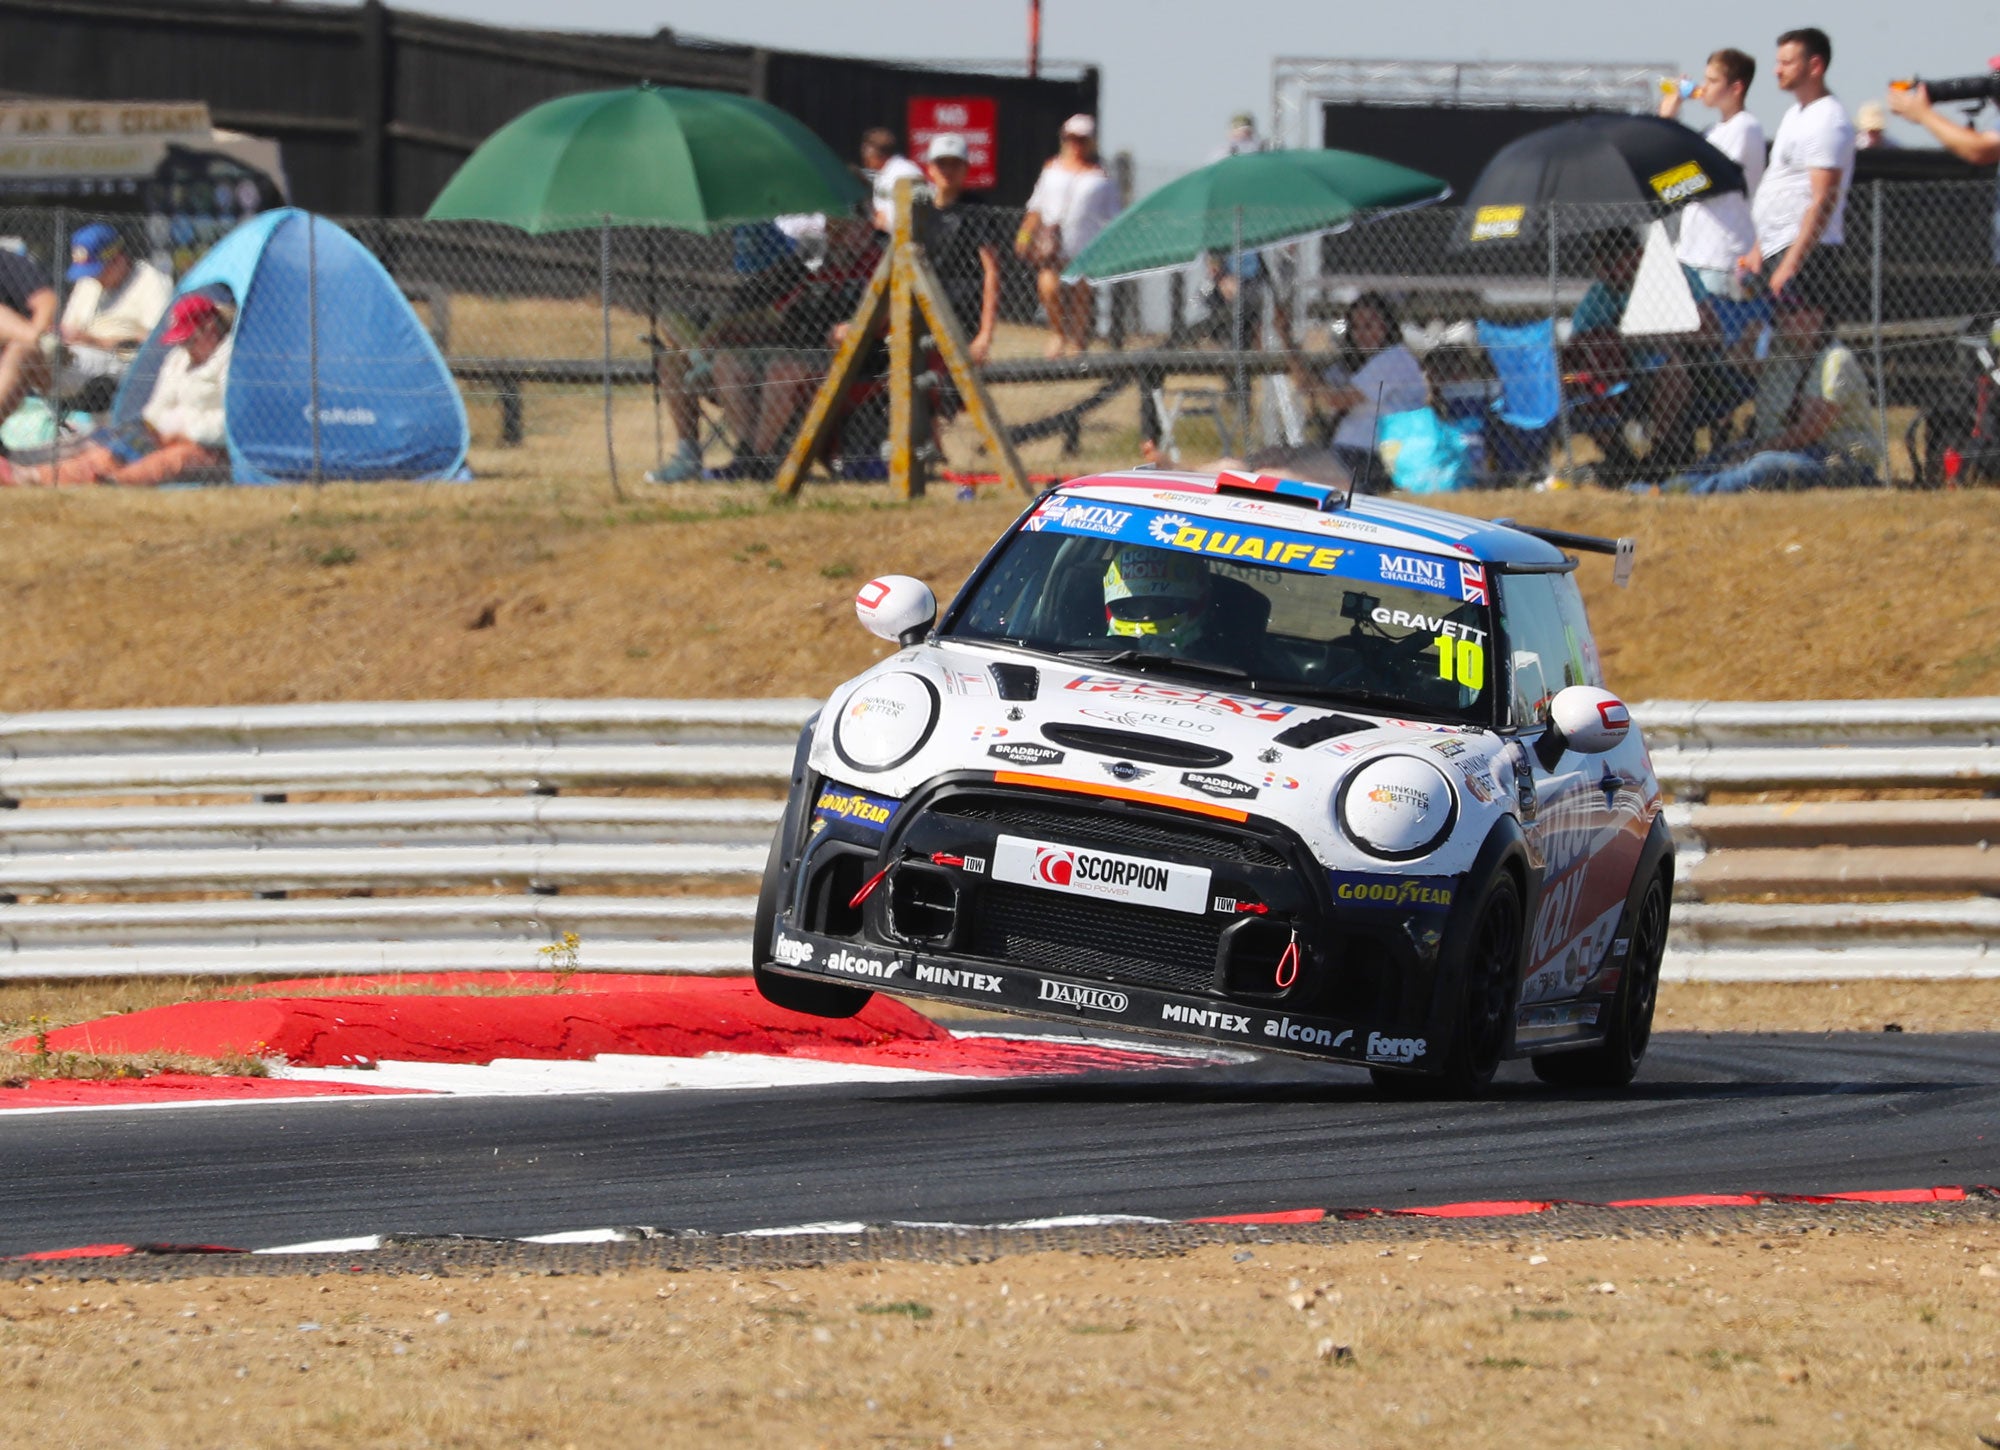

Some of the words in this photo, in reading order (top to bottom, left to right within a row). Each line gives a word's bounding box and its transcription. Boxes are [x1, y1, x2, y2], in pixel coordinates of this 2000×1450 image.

[1172, 526, 1344, 570] QUAIFE
[1379, 554, 1445, 579] MINI
[1380, 571, 1446, 589] CHALLENGE
[1371, 607, 1488, 645] GRAVETT
[1434, 634, 1484, 690] 10
[1124, 710, 1215, 733] CREDO
[995, 744, 1059, 759] BRADBURY
[1008, 753, 1038, 763] RACING
[1113, 766, 1135, 776] MINI
[1187, 773, 1253, 793] BRADBURY
[1202, 783, 1233, 795] RACING
[1374, 783, 1429, 801] THINKING
[1390, 793, 1429, 811] BETTER
[965, 857, 984, 872] TOW
[1076, 855, 1169, 892] SCORPION
[1073, 881, 1093, 890] RED
[1093, 884, 1129, 896] POWER
[1216, 898, 1235, 912] TOW
[827, 949, 883, 978] alcon
[915, 964, 1003, 993] MINTEX
[1037, 978, 1126, 1011] DAMICO
[1162, 1003, 1251, 1034] MINTEX
[1264, 1016, 1334, 1047] alcon
[1366, 1031, 1427, 1063] forge
